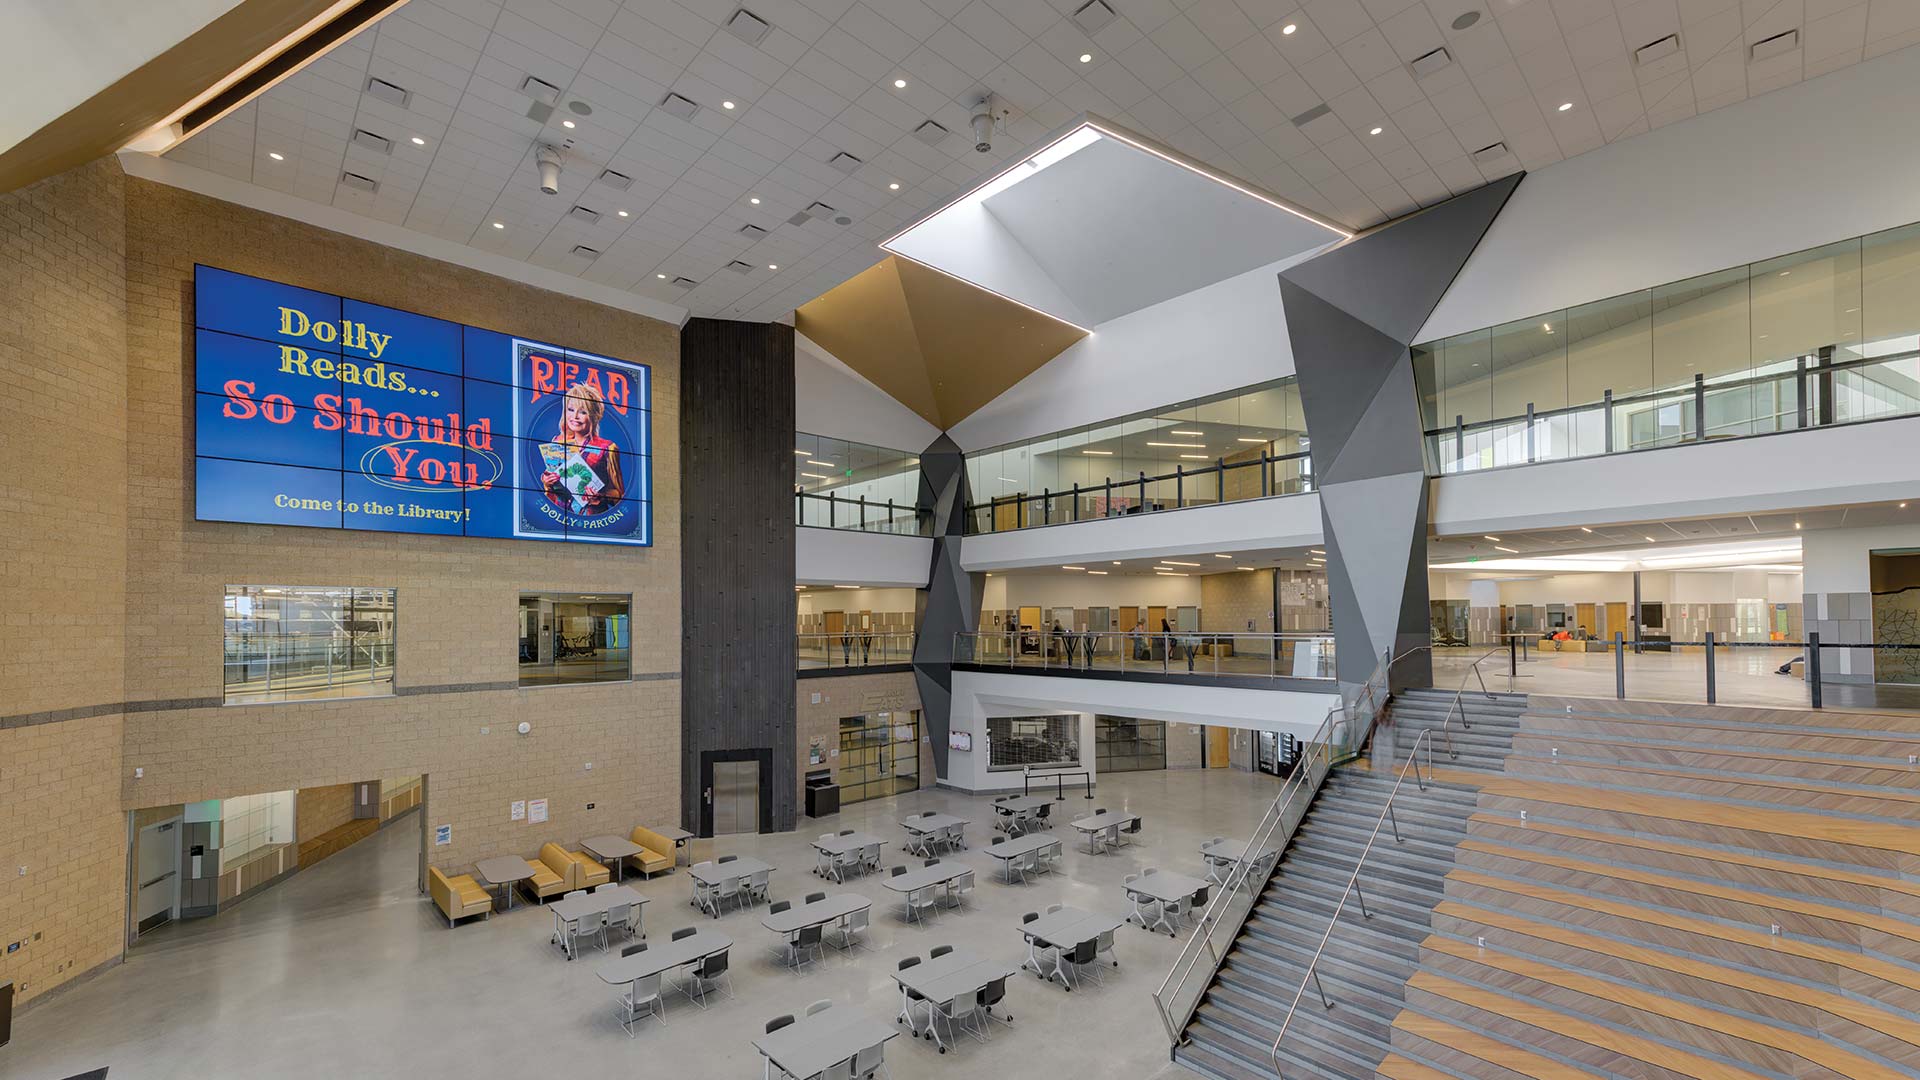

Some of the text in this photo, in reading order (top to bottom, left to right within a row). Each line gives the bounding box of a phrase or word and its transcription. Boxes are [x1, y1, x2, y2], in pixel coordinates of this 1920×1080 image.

[278, 306, 392, 358] Dolly
[278, 345, 440, 398] Reads...
[529, 355, 630, 416] READ
[223, 379, 494, 452] So Should
[380, 446, 493, 491] You.
[274, 494, 471, 523] Come to the Library!
[540, 504, 624, 529] DOLLY PARTON
